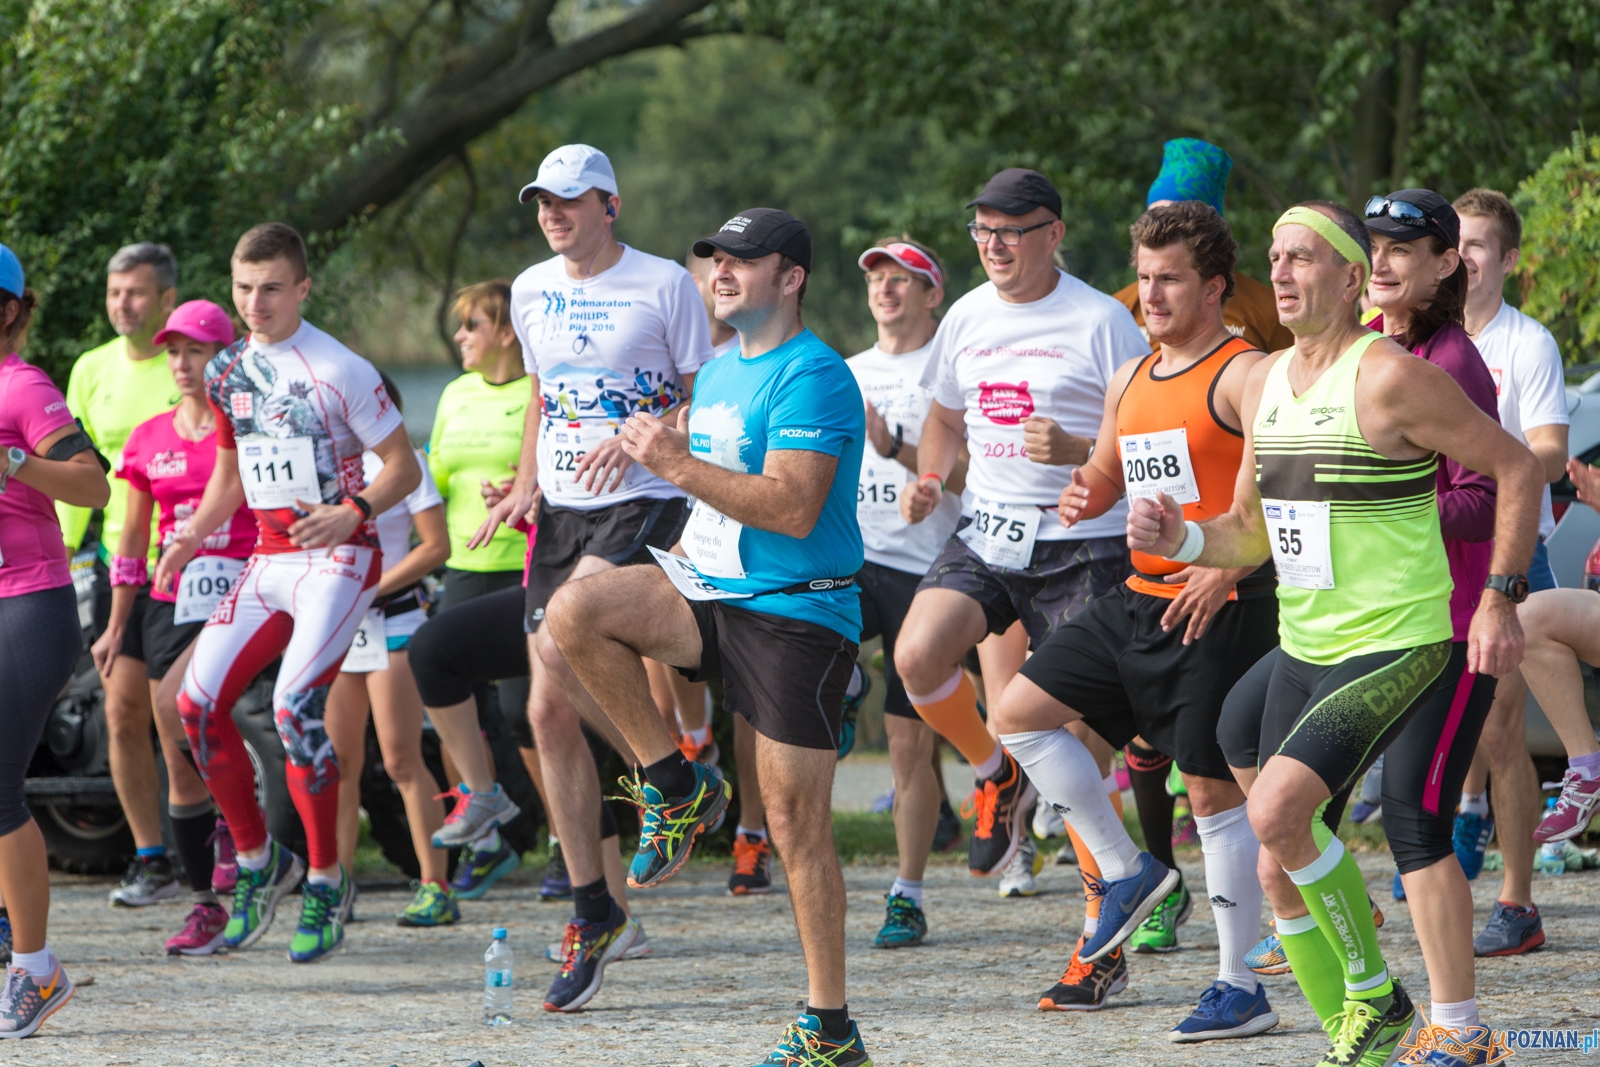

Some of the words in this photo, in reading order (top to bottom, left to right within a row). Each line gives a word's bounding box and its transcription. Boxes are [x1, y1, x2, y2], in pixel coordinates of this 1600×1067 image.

[569, 311, 609, 320] PHILIPS
[591, 323, 615, 332] 2016
[1310, 406, 1345, 415] BROOKS
[700, 438, 710, 449] PKO
[253, 460, 293, 482] 111
[1127, 454, 1181, 483] 2068
[974, 509, 1026, 542] 2375
[1278, 527, 1303, 556] 55
[1362, 651, 1431, 717] CRAFT
